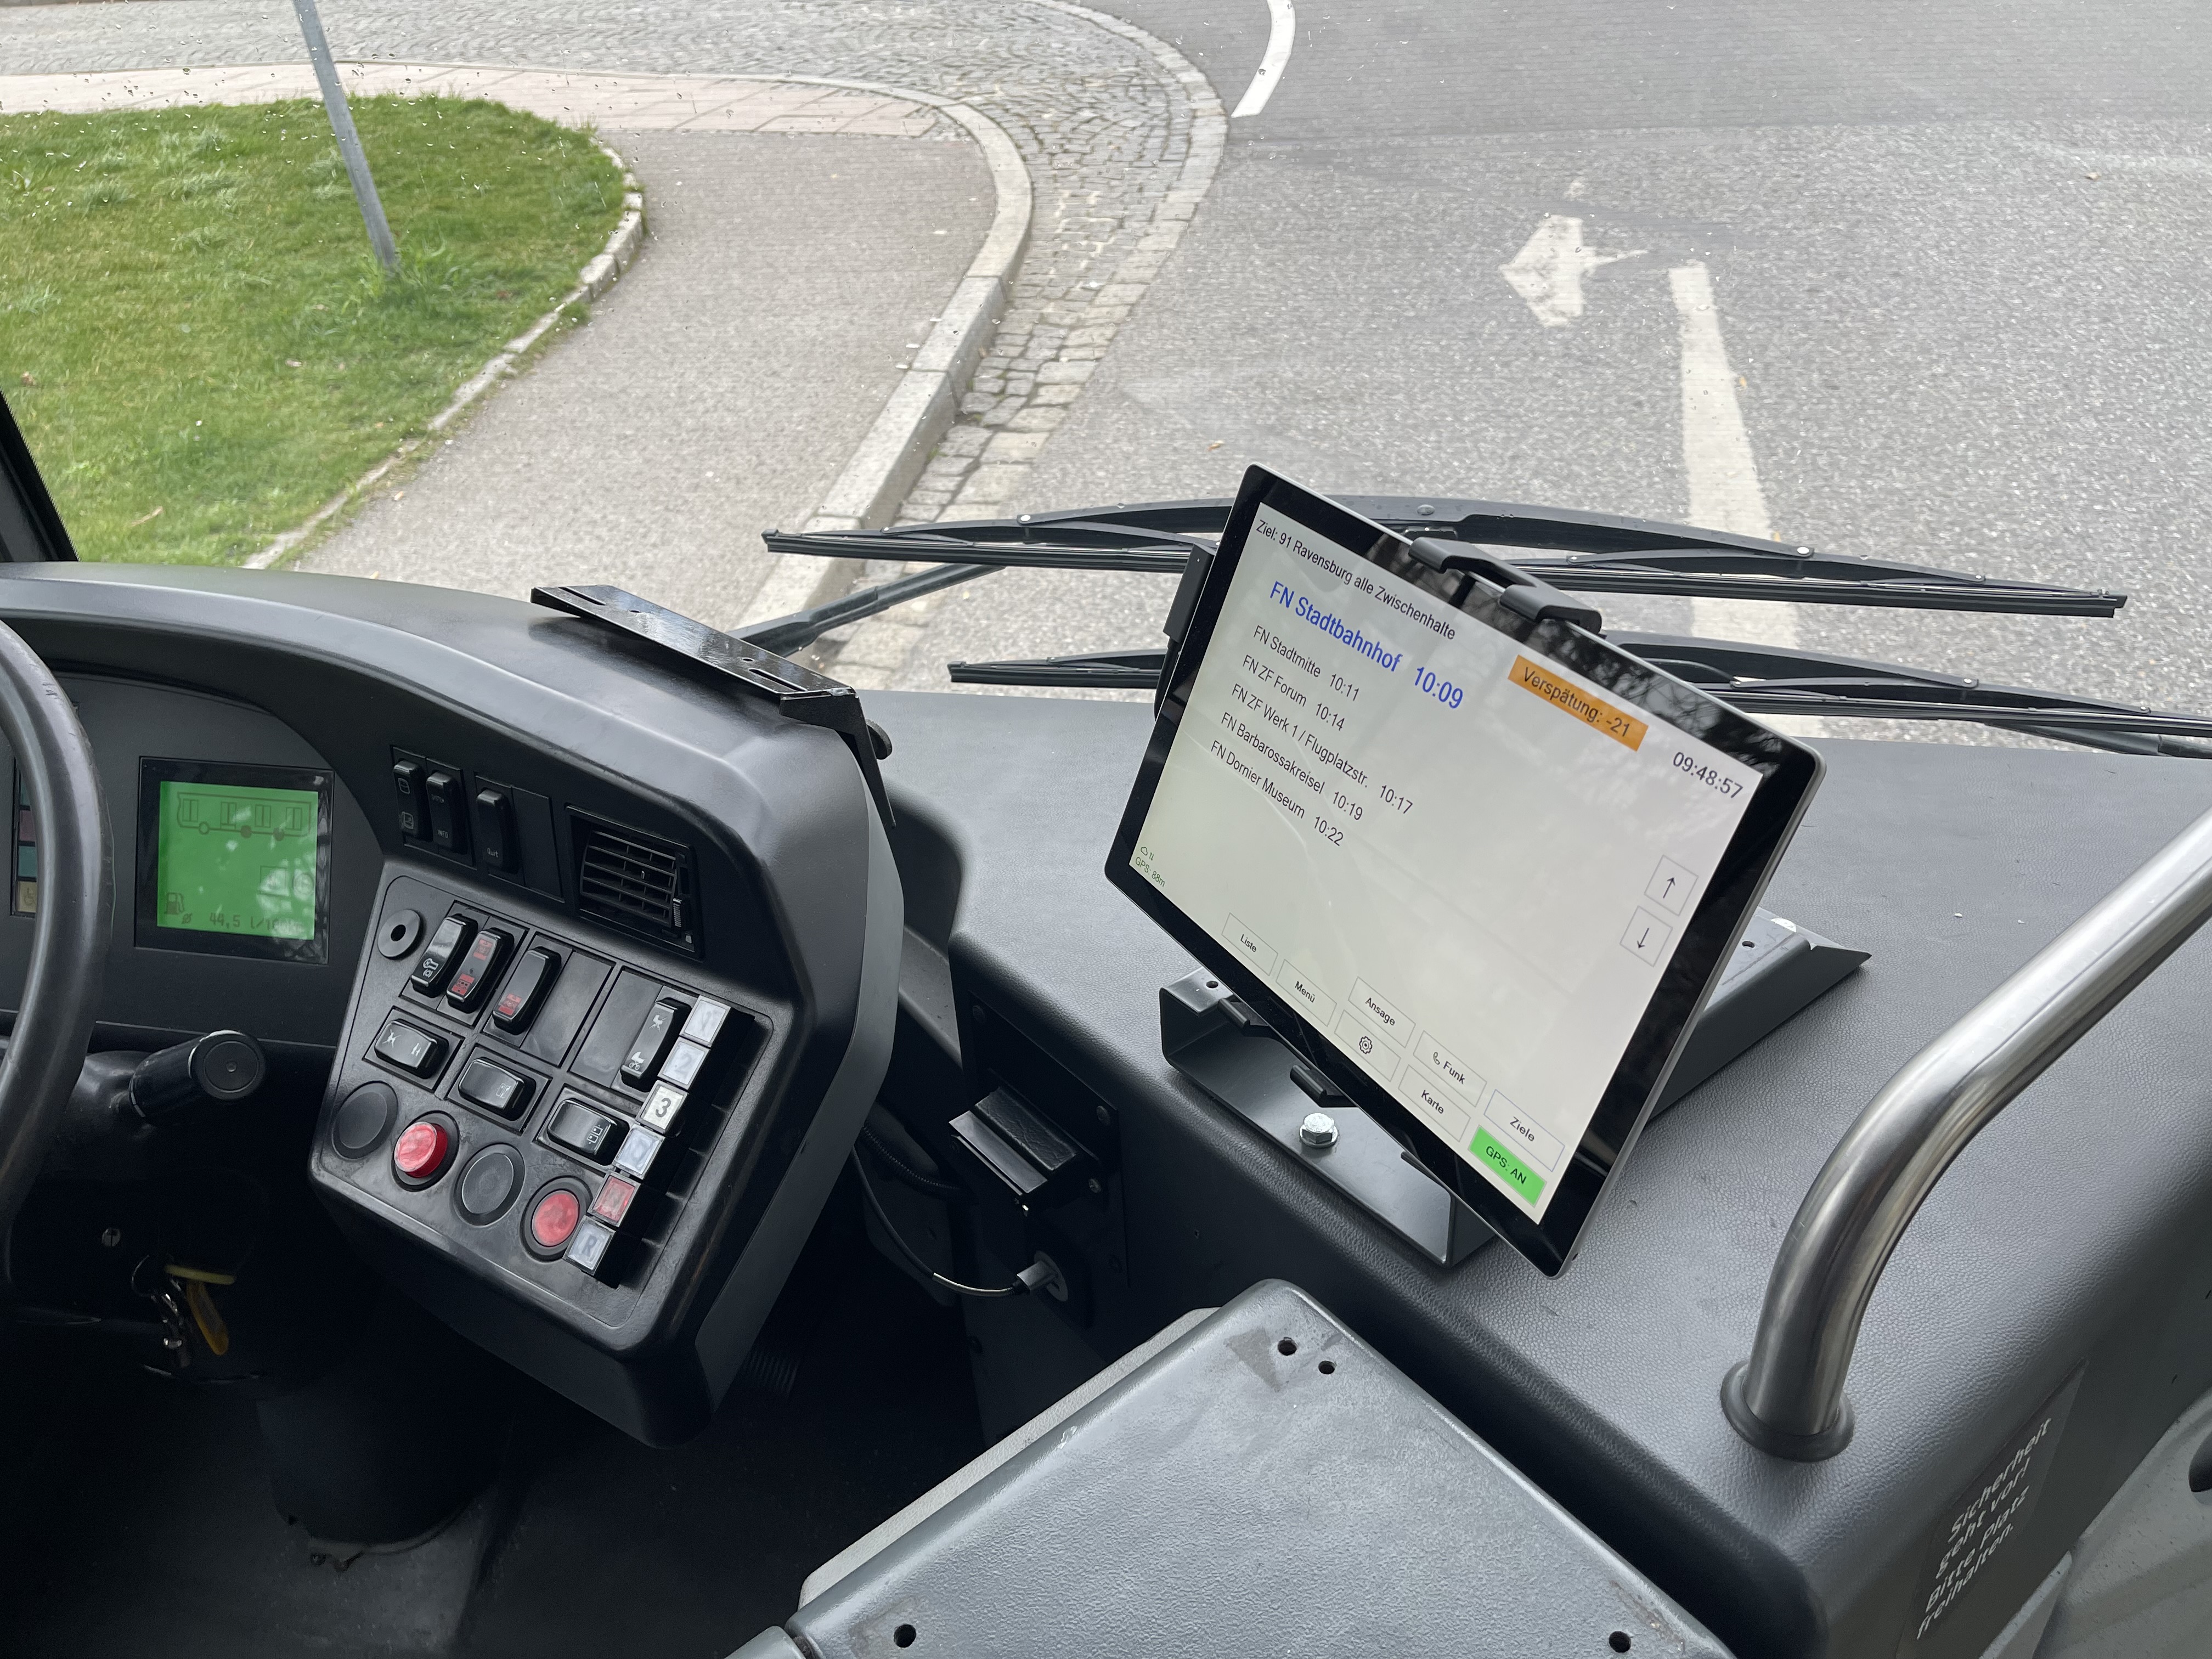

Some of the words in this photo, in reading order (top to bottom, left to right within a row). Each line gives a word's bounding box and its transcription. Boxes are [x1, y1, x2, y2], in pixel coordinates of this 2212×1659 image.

[1256, 519, 1278, 541] Ziel:
[1279, 532, 1291, 549] 91
[1293, 540, 1353, 584] Ravensburg
[1354, 575, 1374, 594] alle
[1374, 586, 1455, 640] Zwischenhalte
[1253, 625, 1269, 645] FN
[1270, 633, 1321, 678] Stadtmitte
[1329, 674, 1359, 702] 10:11
[1270, 581, 1294, 608] FN
[1295, 596, 1403, 673] Stadtbahnhof
[1414, 667, 1464, 709] 10:09
[1242, 654, 1259, 674] FN
[1257, 663, 1273, 682] ZF
[1274, 675, 1307, 707] Forum
[1316, 703, 1345, 731] 10:14
[1523, 666, 1602, 723] Verspätung:
[1606, 717, 1630, 737] -21
[1221, 712, 1237, 731] FN
[1237, 723, 1325, 794] Barbarossakreisel
[1333, 791, 1363, 821] 10:19
[1232, 684, 1248, 703] FN
[1247, 692, 1262, 712] ZF
[1264, 704, 1289, 733] Werk
[1292, 725, 1299, 737] 1
[1298, 730, 1306, 741] /
[1305, 734, 1368, 788] Flugplatzstr.
[1380, 785, 1413, 815] 10:17
[1672, 752, 1743, 798] 09:48:57
[1210, 740, 1226, 760] FN
[1226, 751, 1262, 786] Dornier
[1262, 778, 1305, 819] Museum
[1314, 816, 1344, 846] 10:22
[1135, 857, 1151, 875] GPS:
[209, 912, 241, 929] 44,5
[1240, 934, 1257, 952] Liste
[1295, 980, 1316, 1003] Menü
[1365, 997, 1395, 1026] Ansage
[1443, 1060, 1465, 1085] Funk
[654, 1098, 672, 1118] 3
[1421, 1090, 1444, 1114] Karte
[1510, 1116, 1535, 1142] Ziele
[1486, 1146, 1510, 1171] GPS:
[1510, 1168, 1527, 1185] AN
[581, 1234, 597, 1257] R
[1948, 1418, 2051, 1542] Sicherheit
[1936, 1510, 1986, 1579] geht
[1991, 1457, 2030, 1512] vor!
[1925, 1548, 1975, 1613] Bitte
[1980, 1485, 2029, 1550] Platz
[1916, 1523, 2013, 1640] freihalten.
